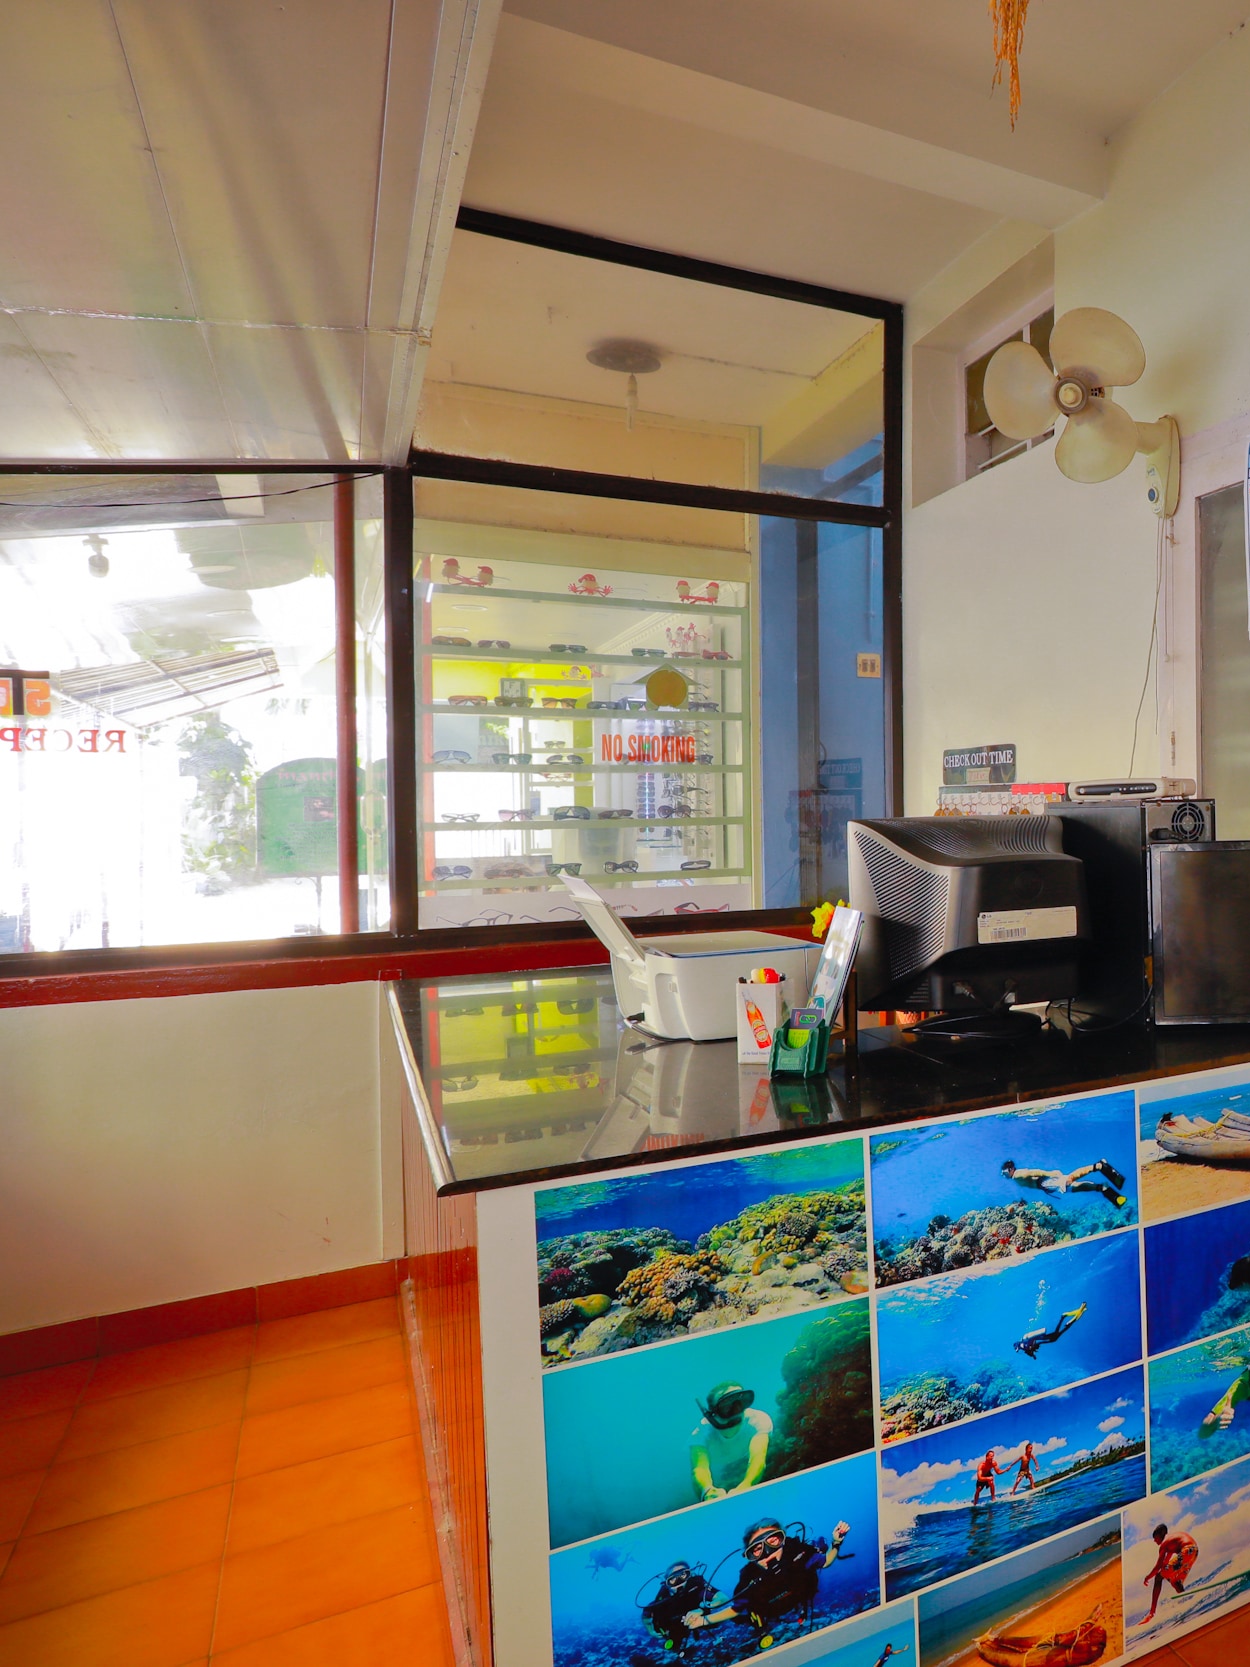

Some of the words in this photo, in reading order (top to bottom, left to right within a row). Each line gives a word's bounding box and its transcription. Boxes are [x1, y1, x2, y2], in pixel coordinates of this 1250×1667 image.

[601, 733, 622, 762] NO
[628, 734, 696, 763] SMOKING
[944, 754, 970, 768] CHECK
[971, 752, 987, 766] OUT
[989, 750, 1013, 765] TIME
